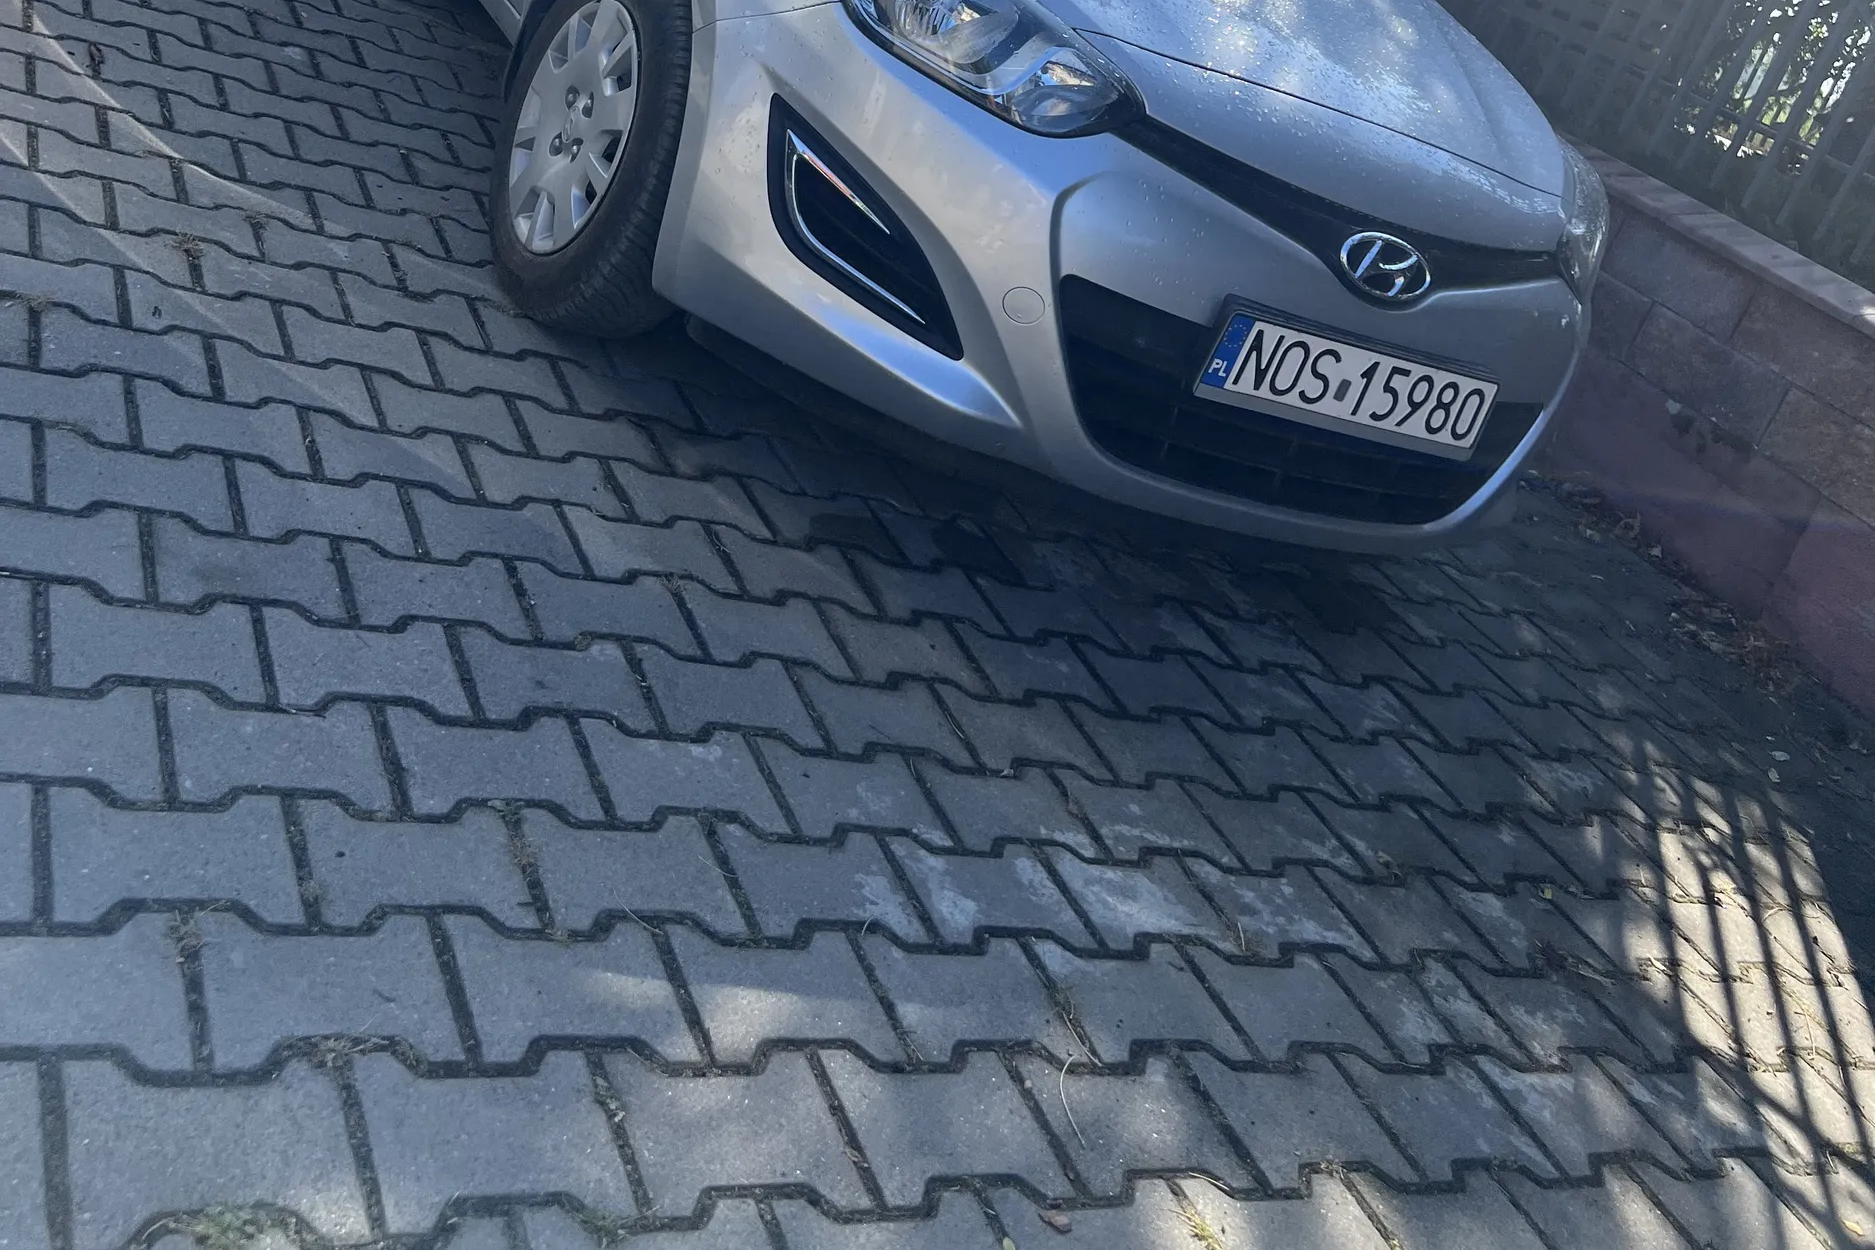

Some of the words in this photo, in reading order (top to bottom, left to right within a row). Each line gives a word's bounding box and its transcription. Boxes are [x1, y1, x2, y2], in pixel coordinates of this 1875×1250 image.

[1207, 358, 1228, 378] PL
[1231, 328, 1342, 405] NOS
[1349, 360, 1486, 442] 15980
